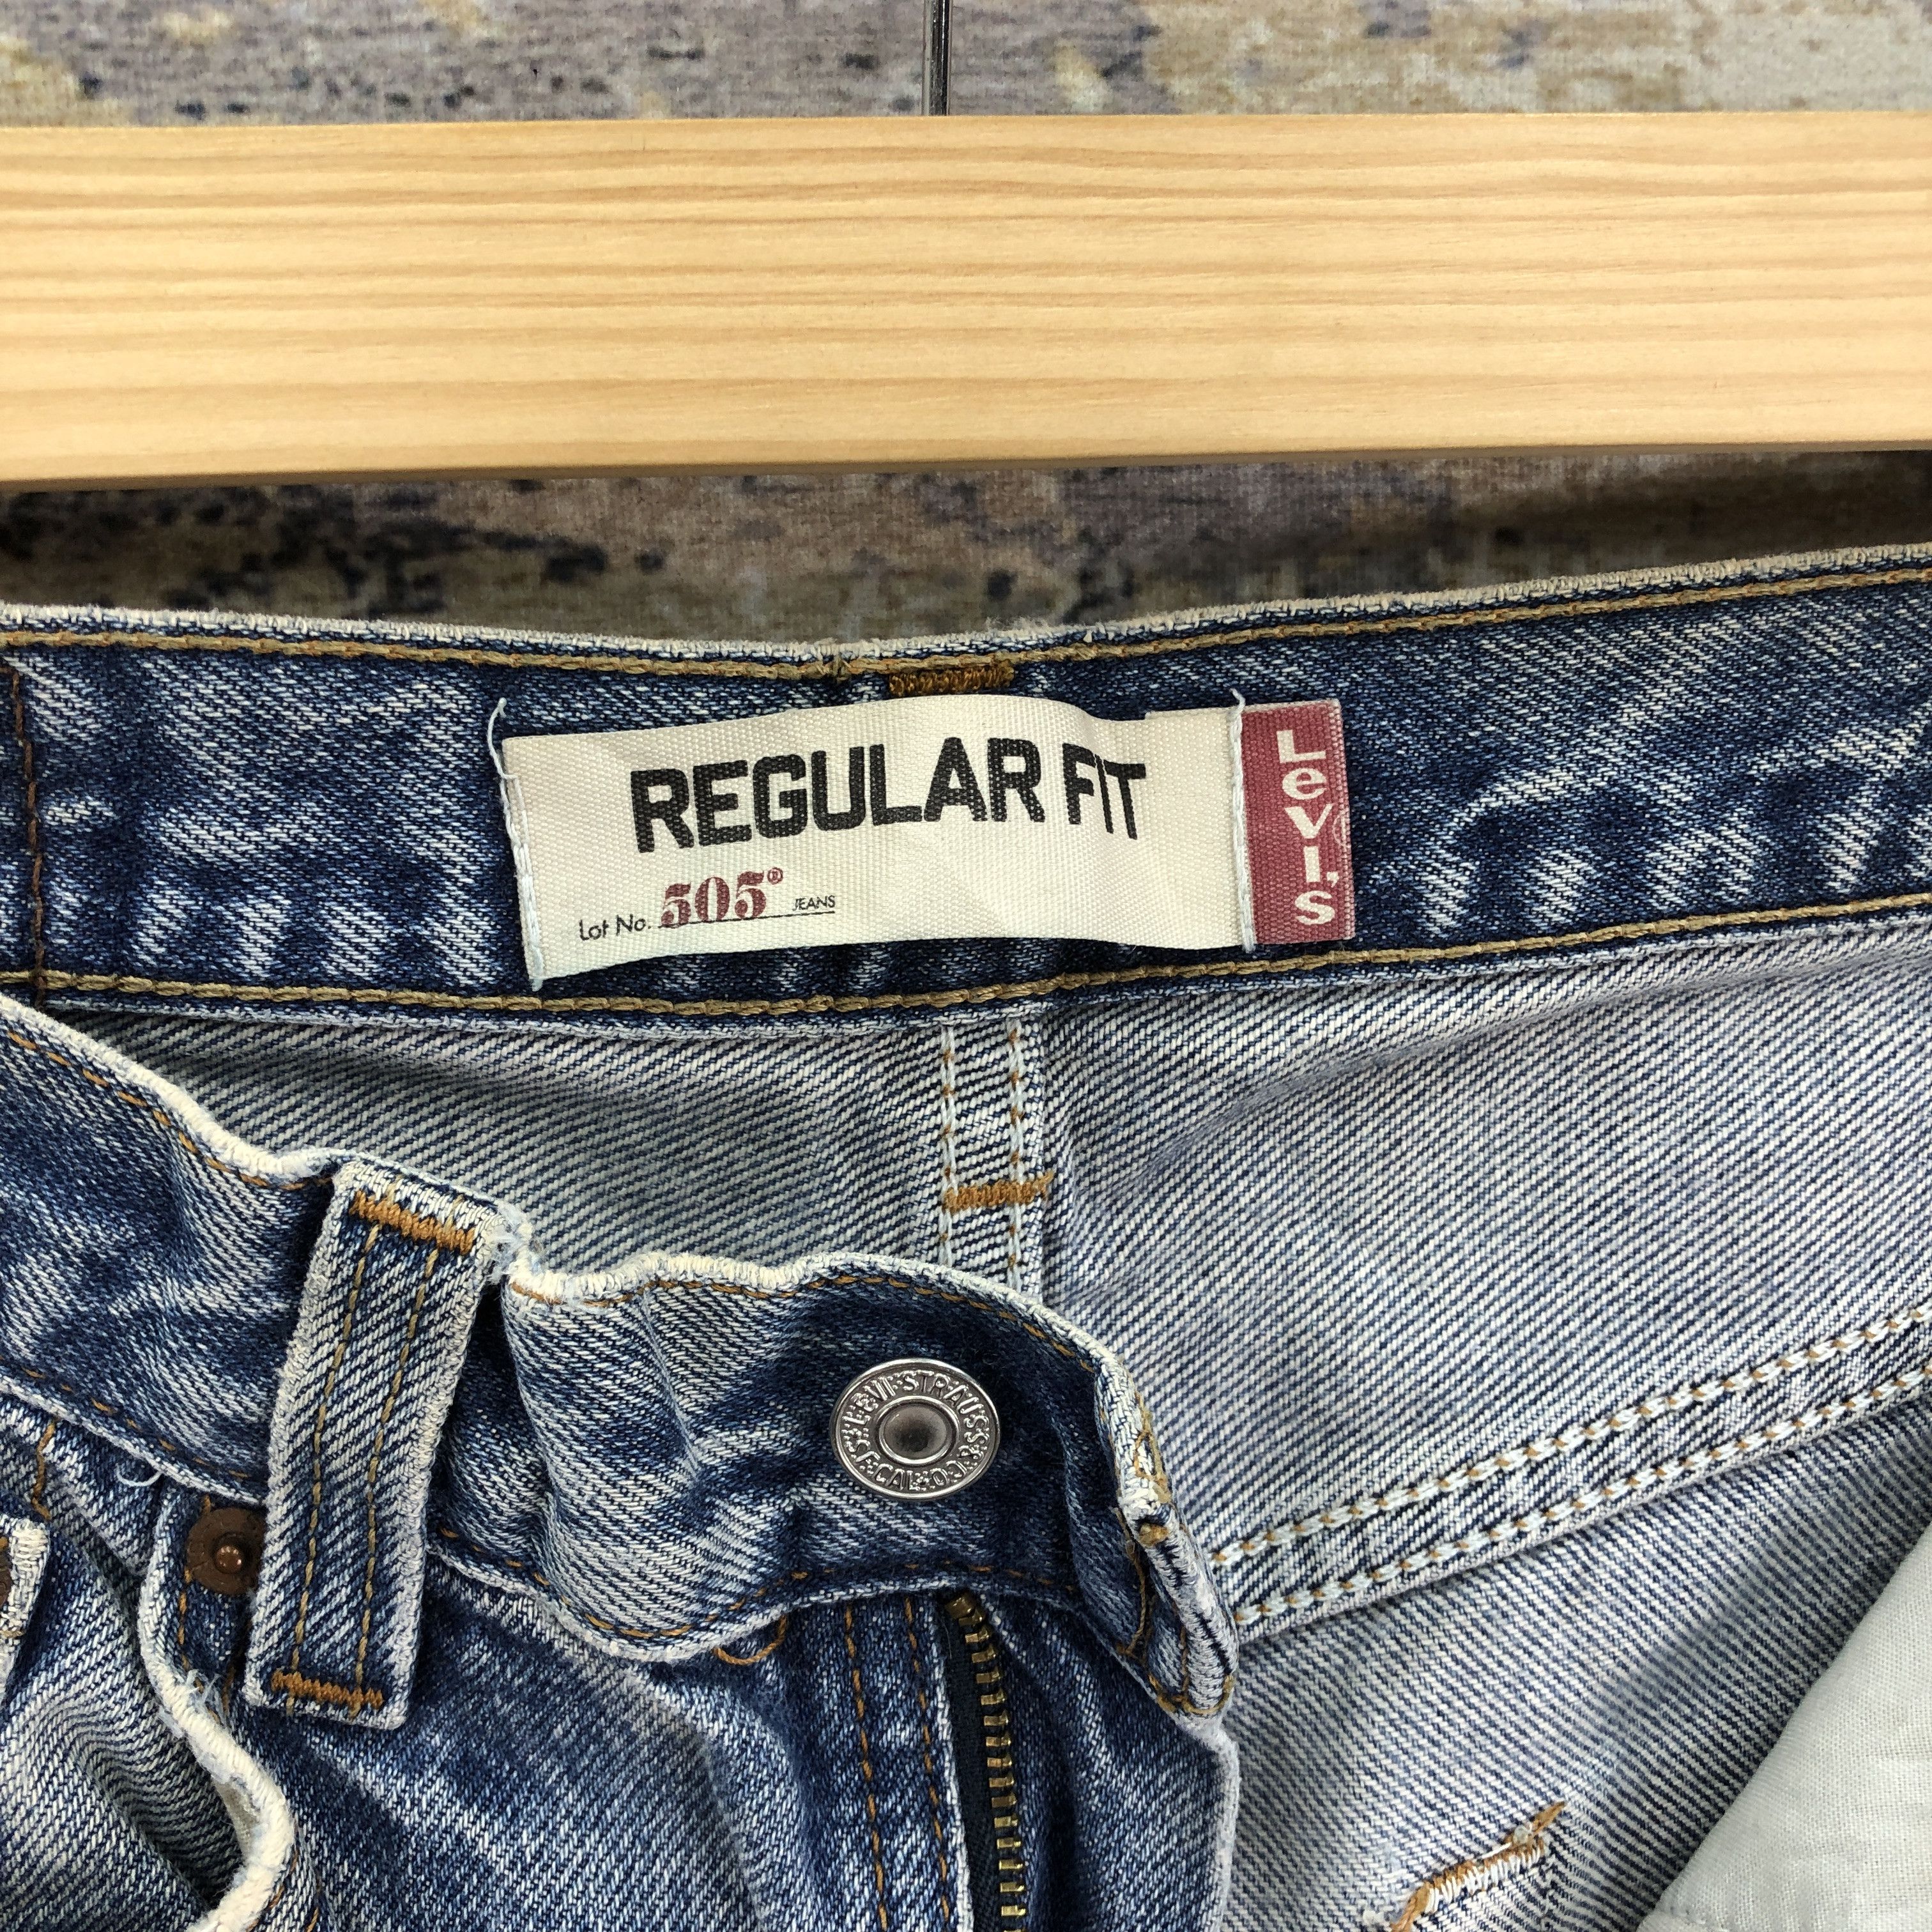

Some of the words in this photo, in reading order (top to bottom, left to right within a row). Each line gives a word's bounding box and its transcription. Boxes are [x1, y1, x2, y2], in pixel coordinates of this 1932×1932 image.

[631, 737, 1045, 854] REGULAR
[1062, 743, 1147, 839] FIT
[579, 919, 610, 941] Lot
[616, 914, 652, 937] No.
[792, 894, 836, 912] JEANS
[842, 1376, 896, 1425] LEVI
[901, 1370, 990, 1445] STRAUSS
[958, 1445, 985, 1461] &
